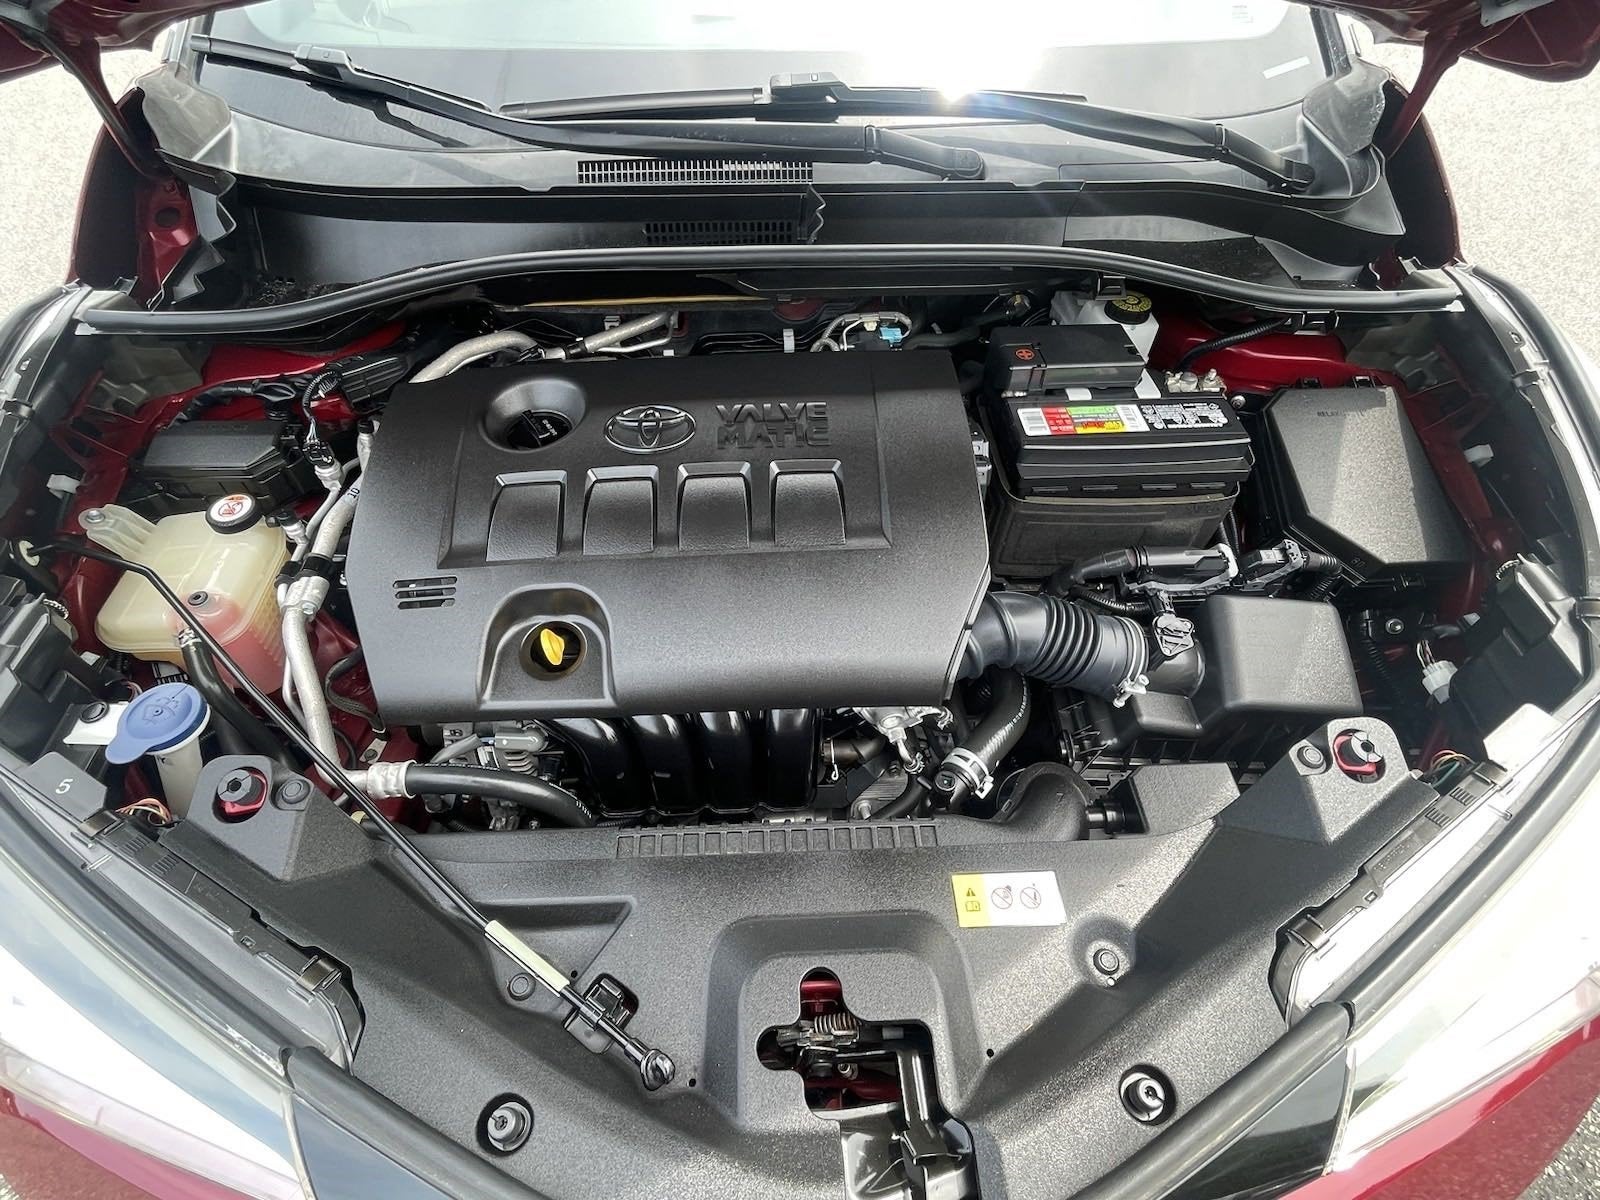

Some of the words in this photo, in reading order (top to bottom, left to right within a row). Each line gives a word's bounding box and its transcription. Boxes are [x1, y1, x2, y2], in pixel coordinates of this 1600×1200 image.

[715, 401, 828, 425] VALVE
[717, 420, 832, 450] MATIC
[55, 778, 74, 795] 5
